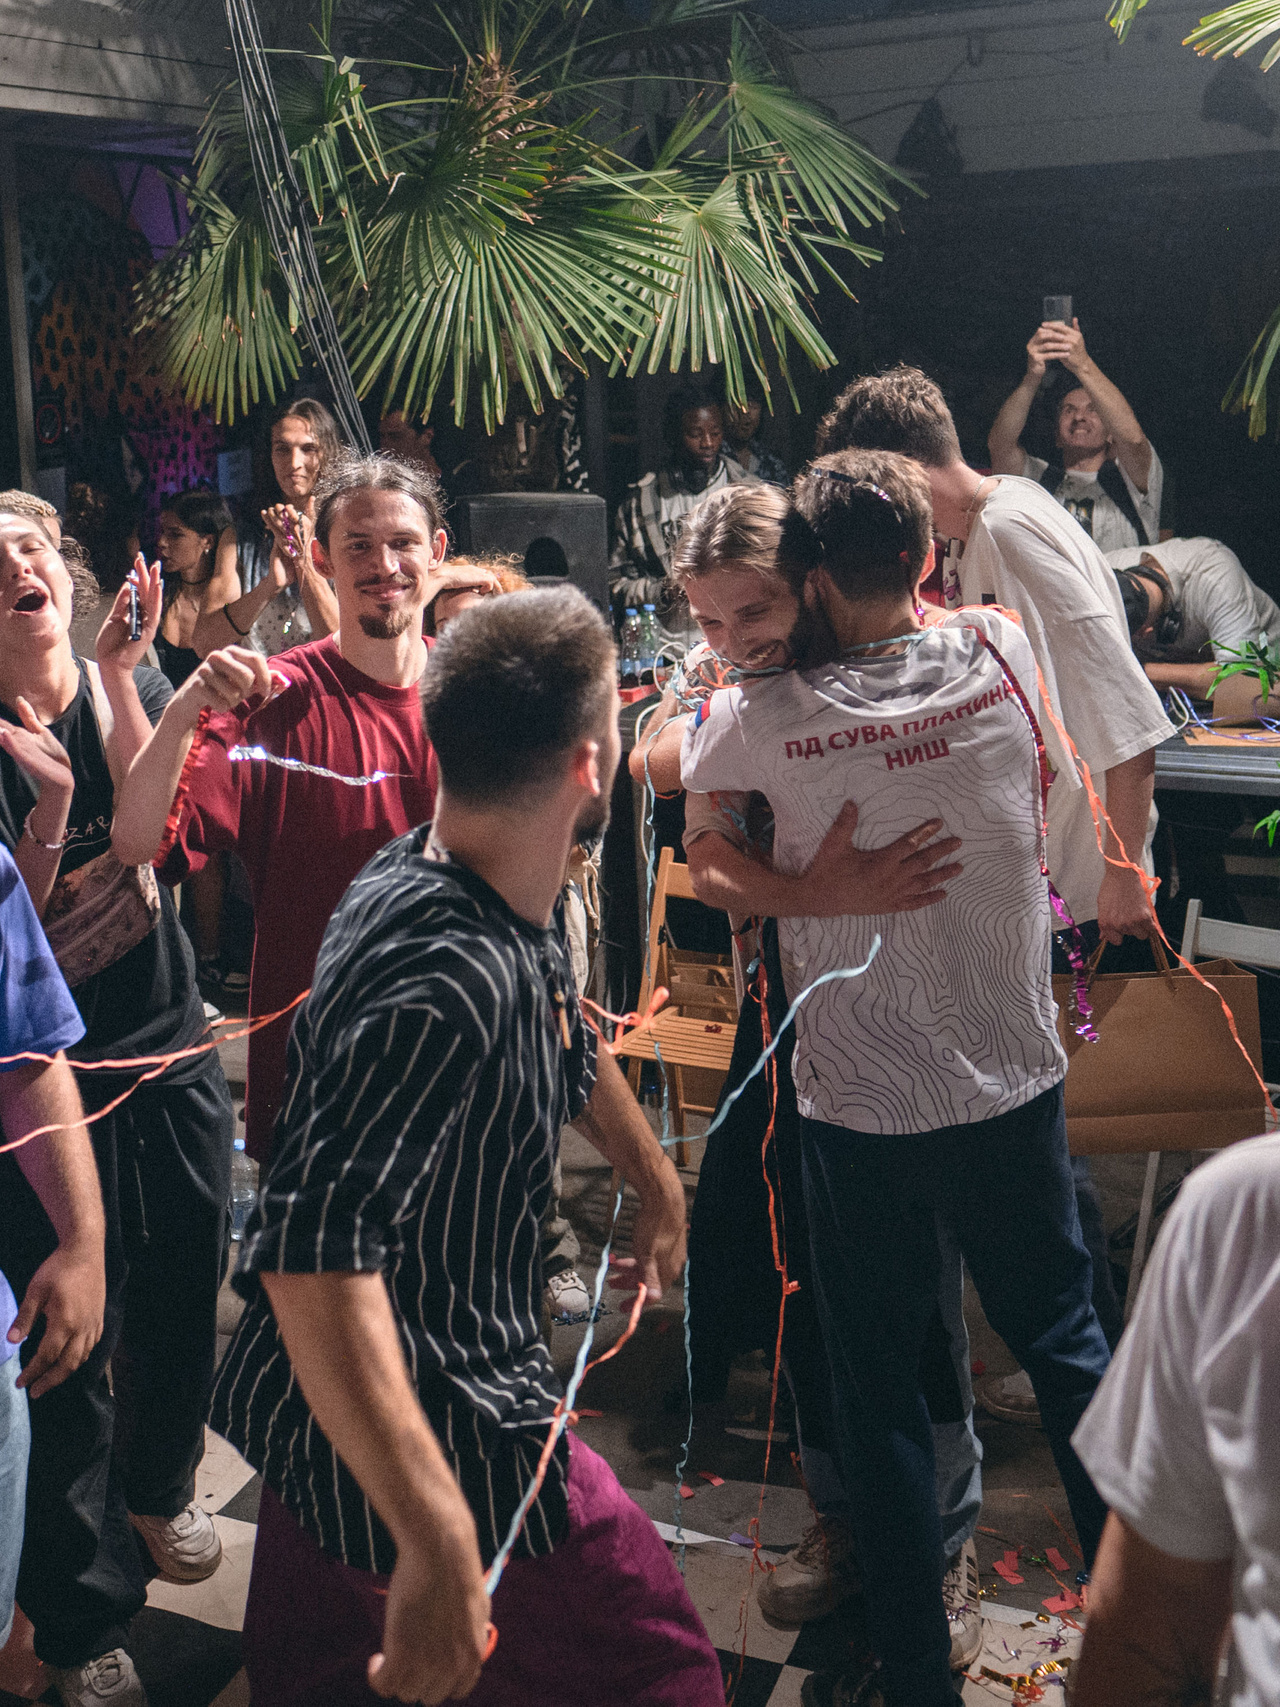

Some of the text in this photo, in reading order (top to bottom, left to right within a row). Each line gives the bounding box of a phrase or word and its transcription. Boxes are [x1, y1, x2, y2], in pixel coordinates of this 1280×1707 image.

[784, 736, 825, 760] ПД
[828, 724, 897, 750] СУВА
[885, 737, 950, 771] НИШ
